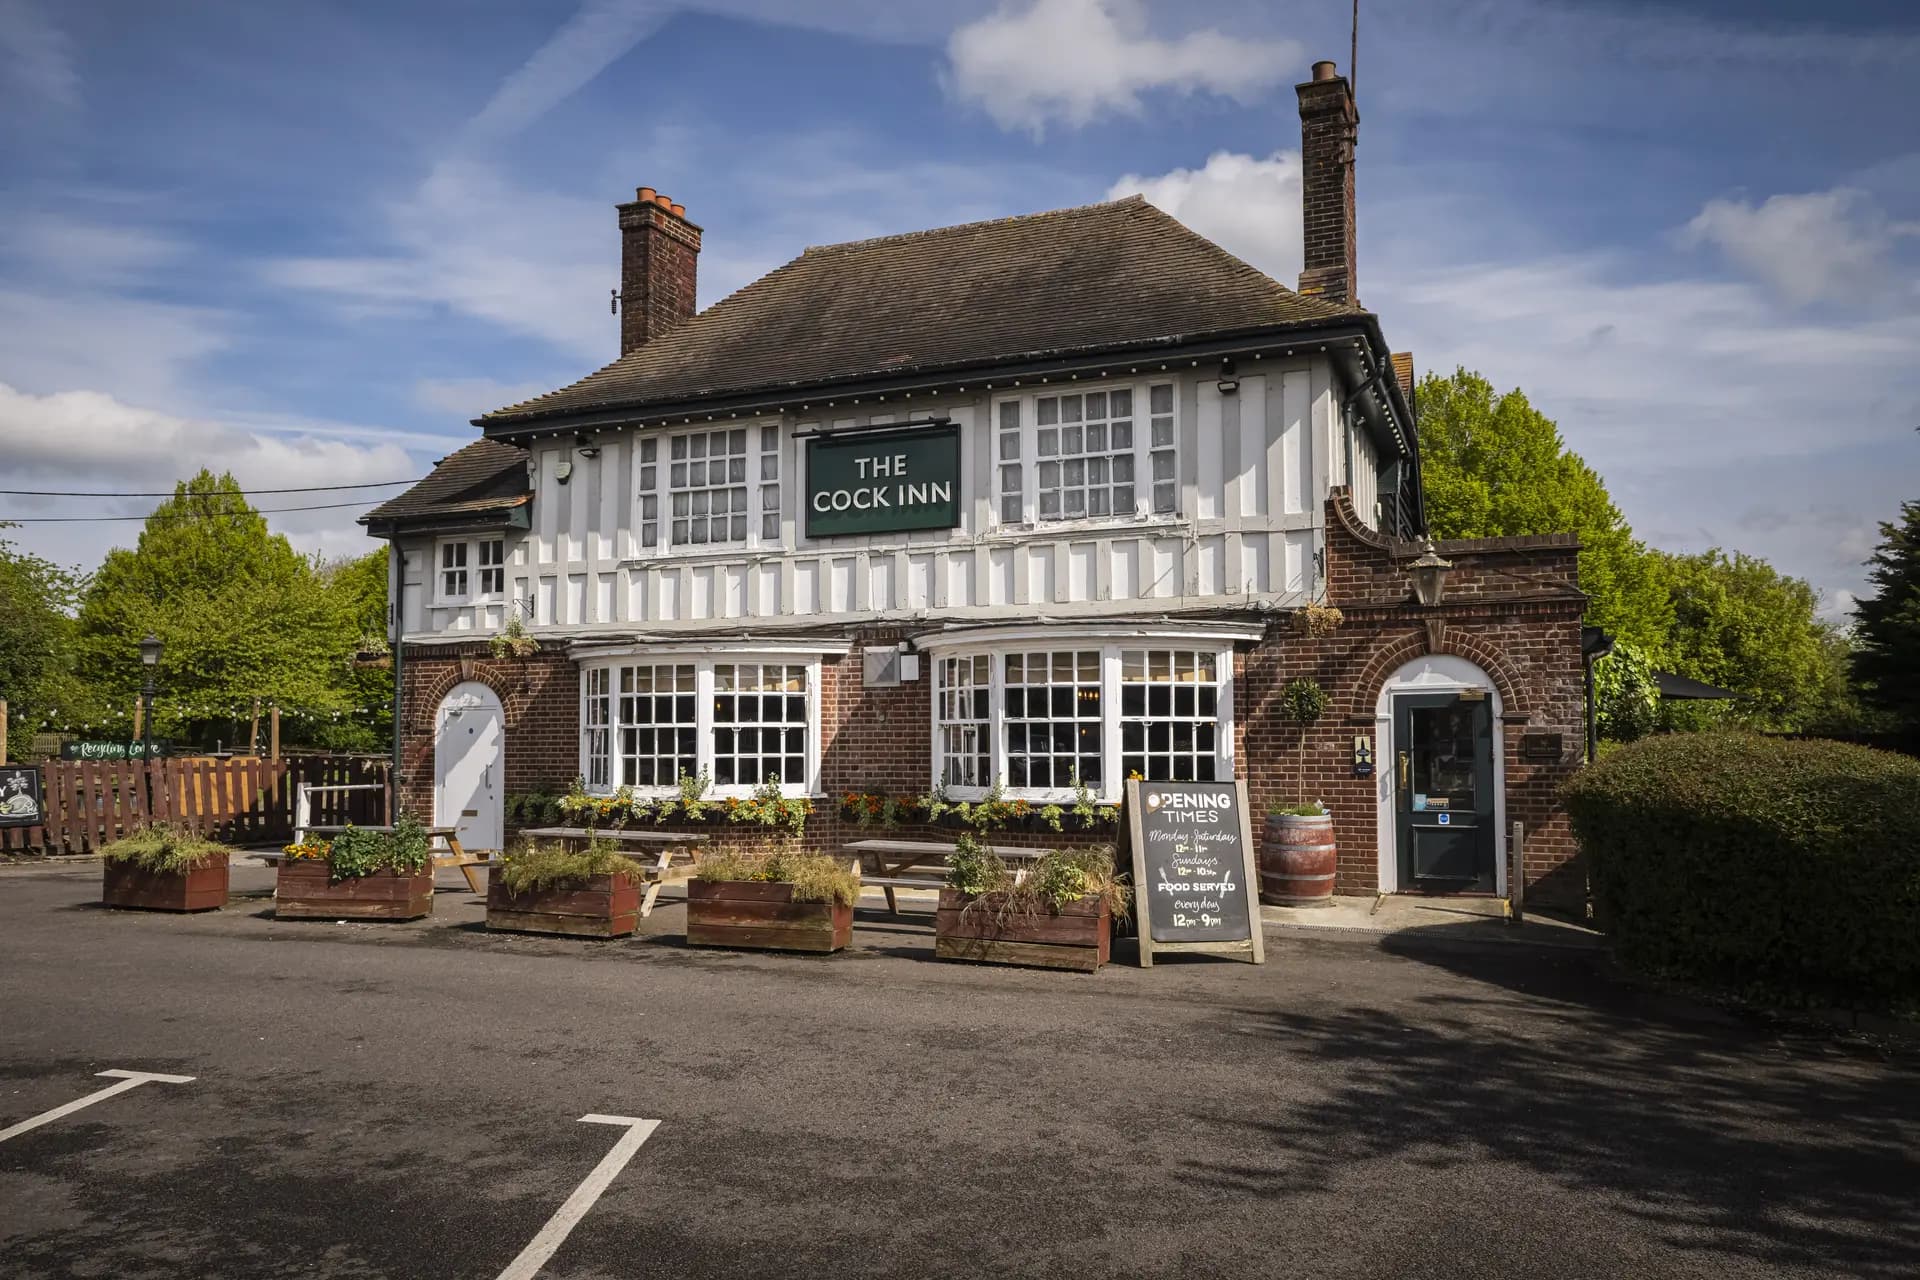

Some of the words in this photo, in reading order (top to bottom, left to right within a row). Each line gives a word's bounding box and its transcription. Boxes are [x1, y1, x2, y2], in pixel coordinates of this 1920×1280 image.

[854, 454, 907, 479] THE
[813, 486, 891, 512] COCK
[898, 480, 951, 506] INN
[80, 740, 126, 758] Recycling
[129, 741, 160, 756] Cenre
[1147, 792, 1231, 809] OPENING
[1162, 810, 1219, 823] TIMES
[1149, 829, 1189, 845] Monday
[1158, 882, 1190, 892] FOOD
[1193, 882, 1236, 892] SERVED
